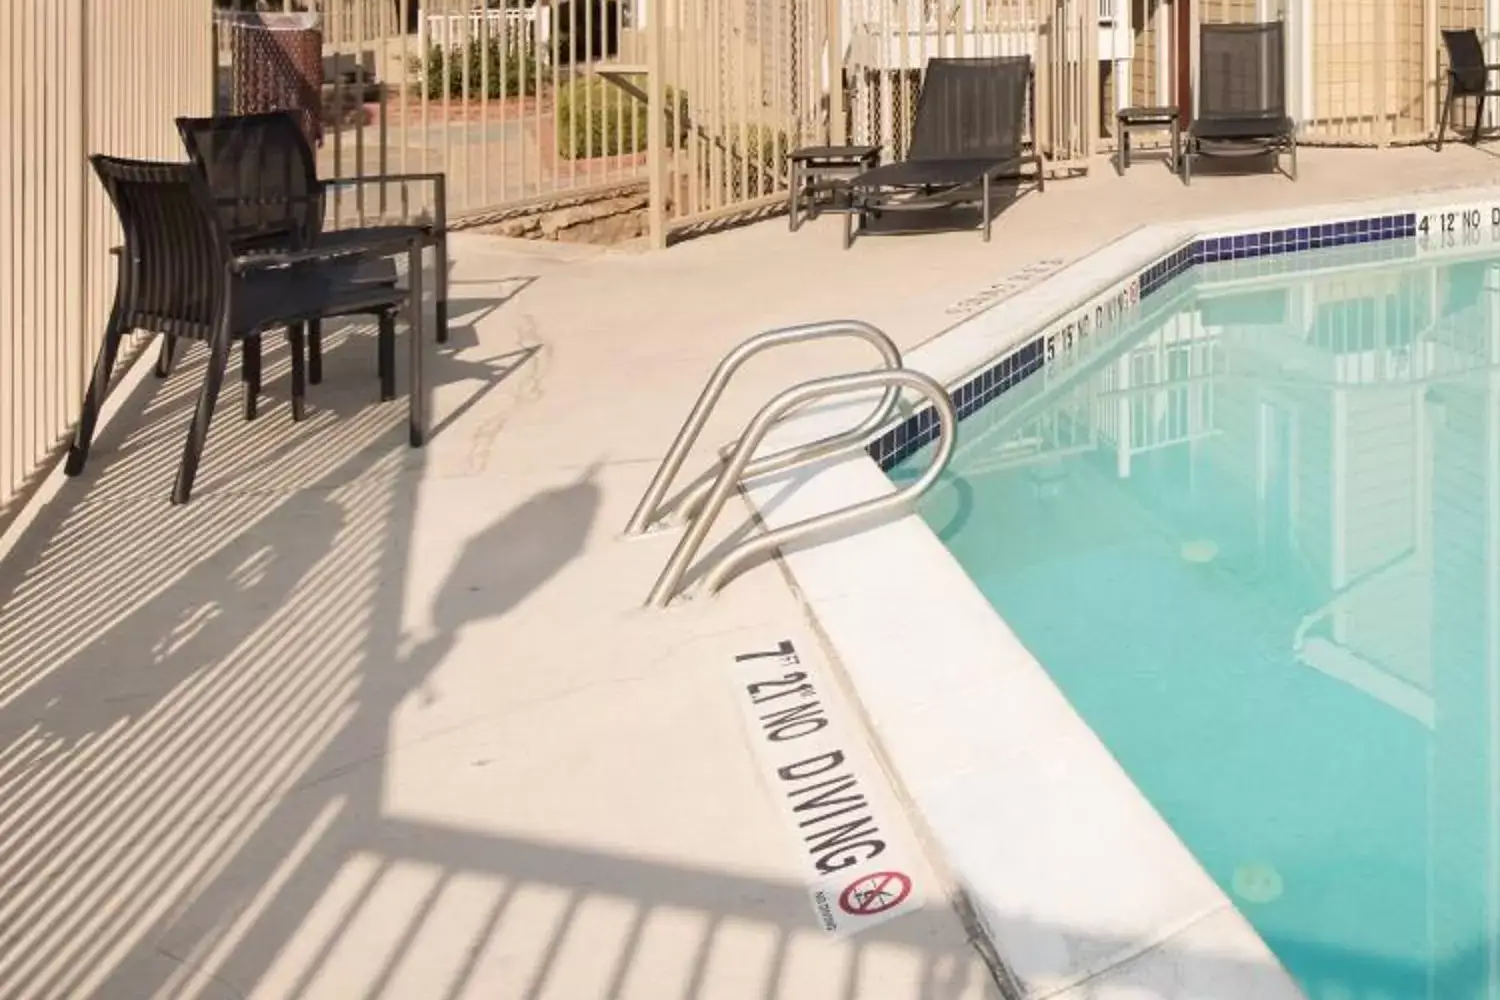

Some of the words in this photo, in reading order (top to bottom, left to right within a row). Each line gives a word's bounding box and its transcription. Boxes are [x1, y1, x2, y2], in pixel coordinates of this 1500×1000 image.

[1462, 209, 1481, 229] NO
[759, 701, 829, 743] NO
[777, 748, 887, 876] DIVING
